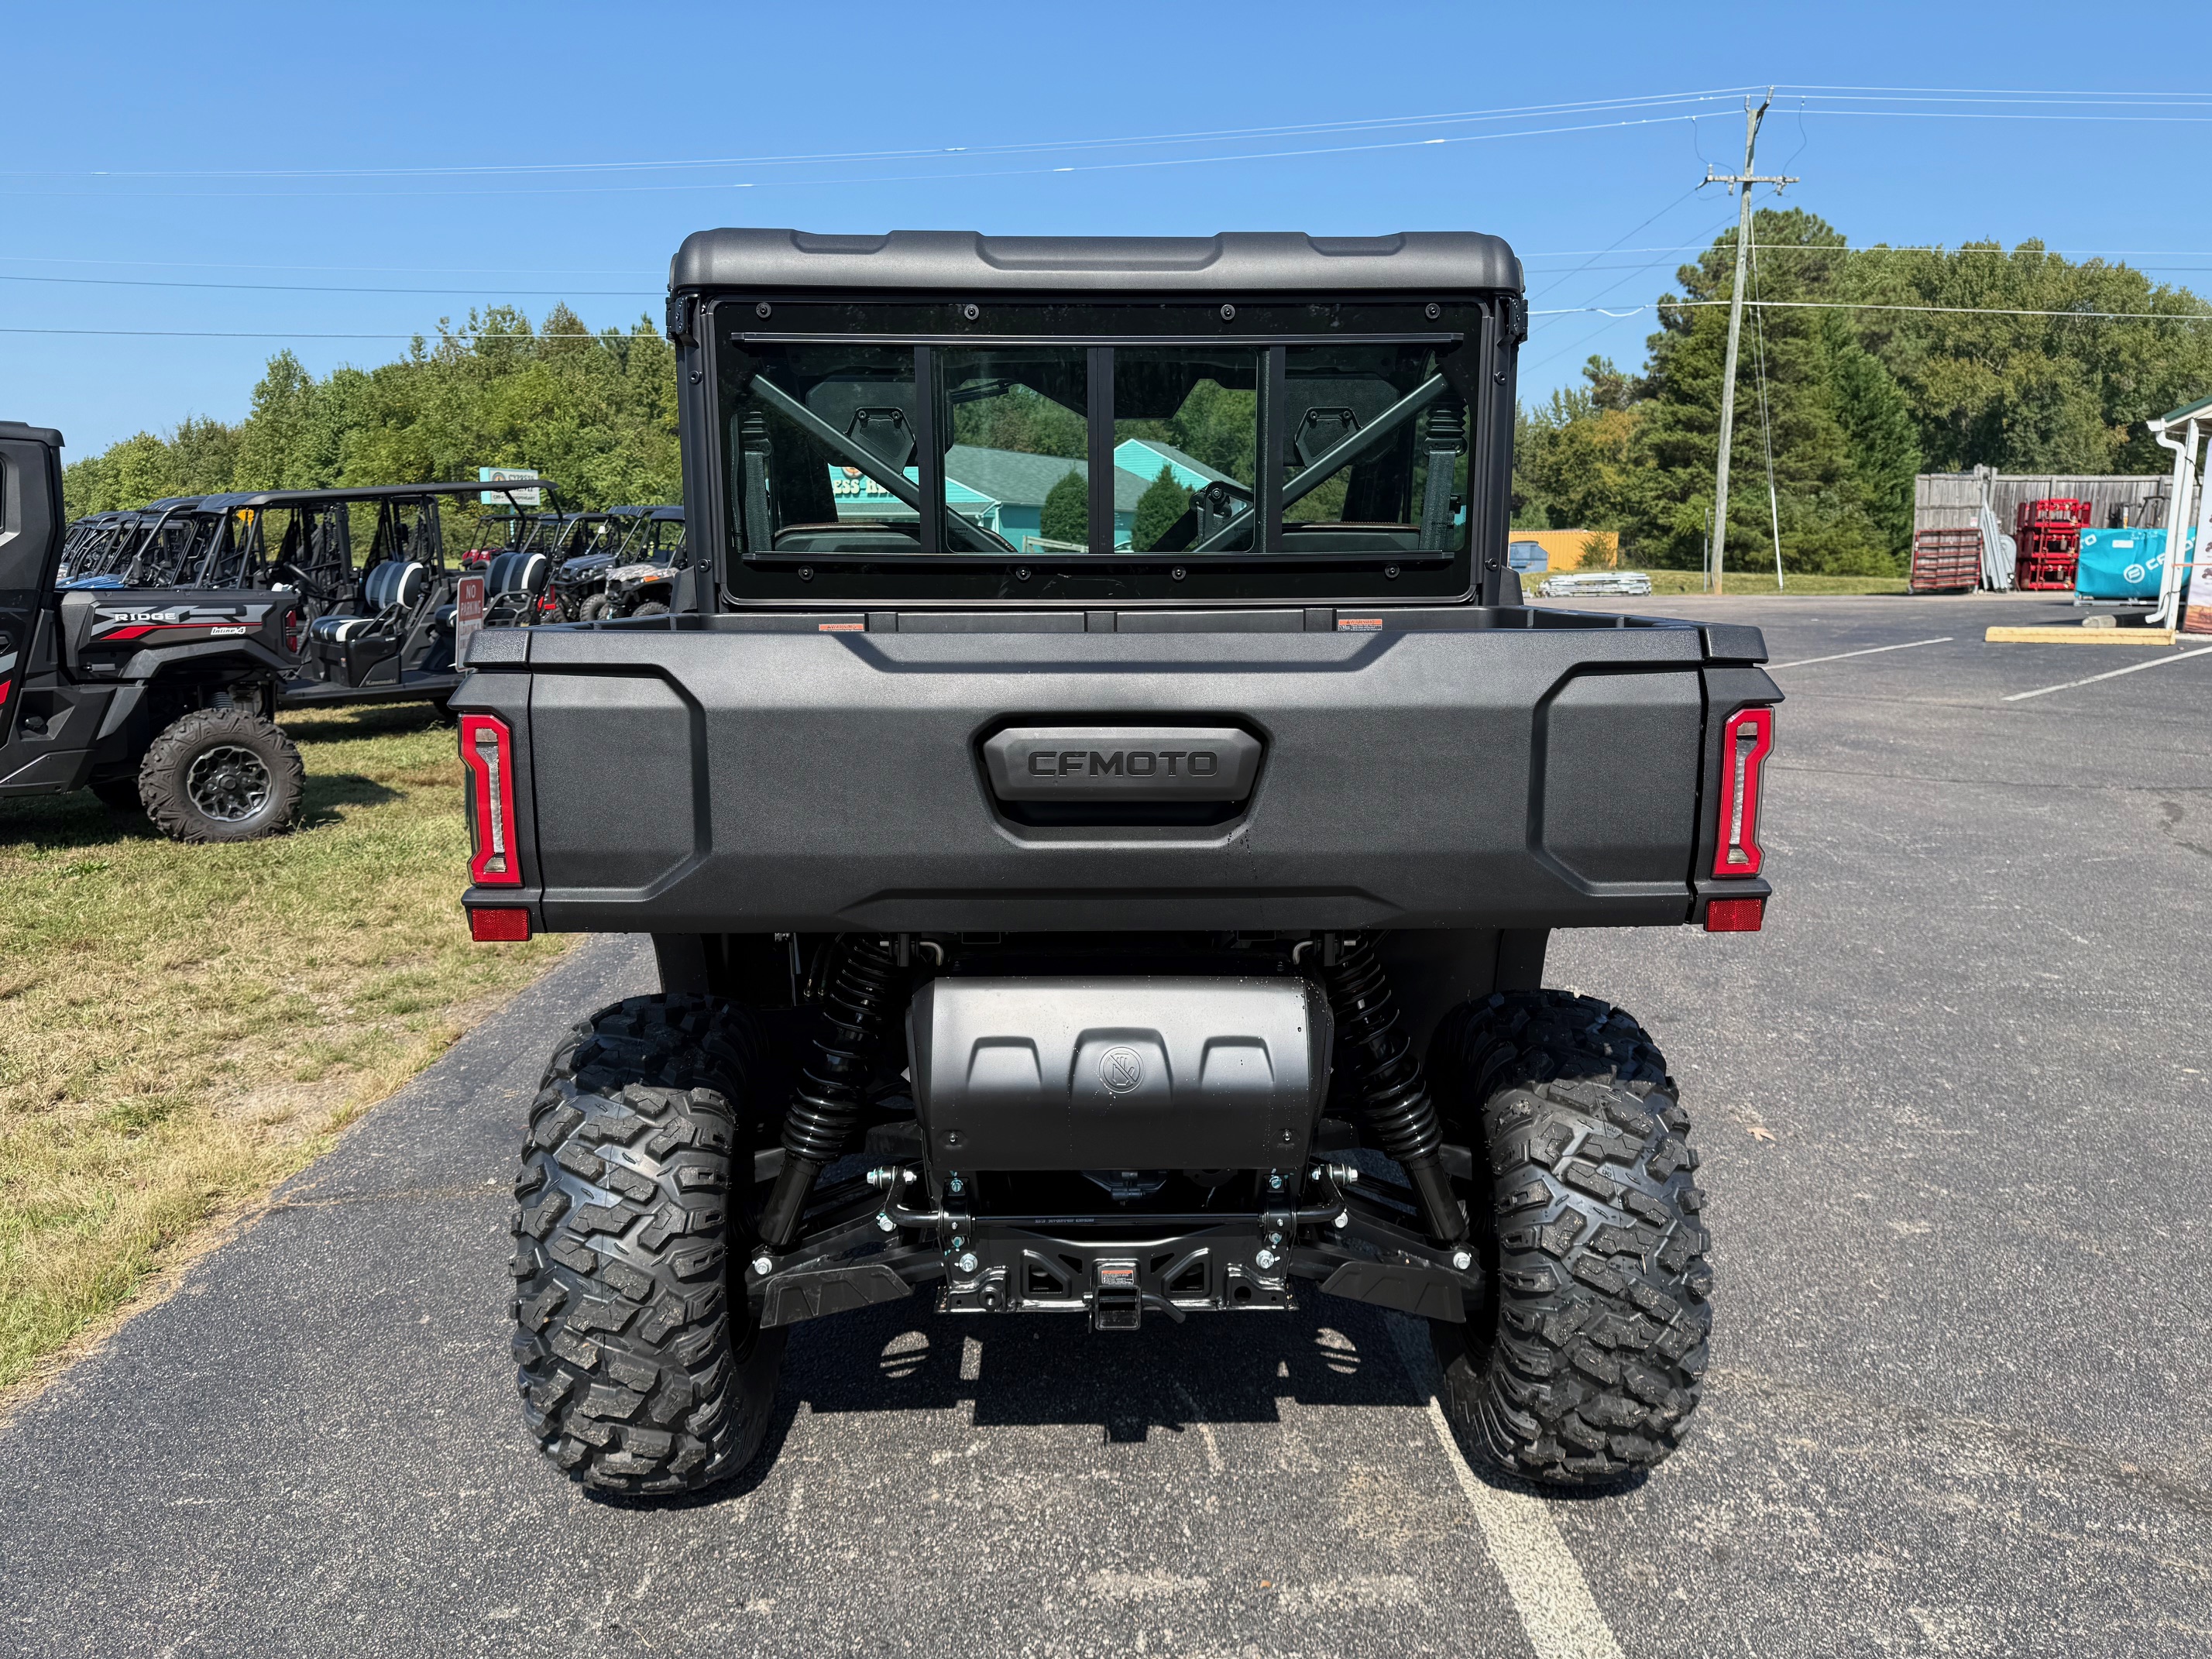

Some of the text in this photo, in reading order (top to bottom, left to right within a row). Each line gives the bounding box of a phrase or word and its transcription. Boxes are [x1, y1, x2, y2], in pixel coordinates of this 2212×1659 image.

[466, 584, 476, 599] NO
[461, 600, 481, 617] PARKING
[115, 613, 176, 621] RIDGE
[1029, 751, 1218, 776] CFMOTO
